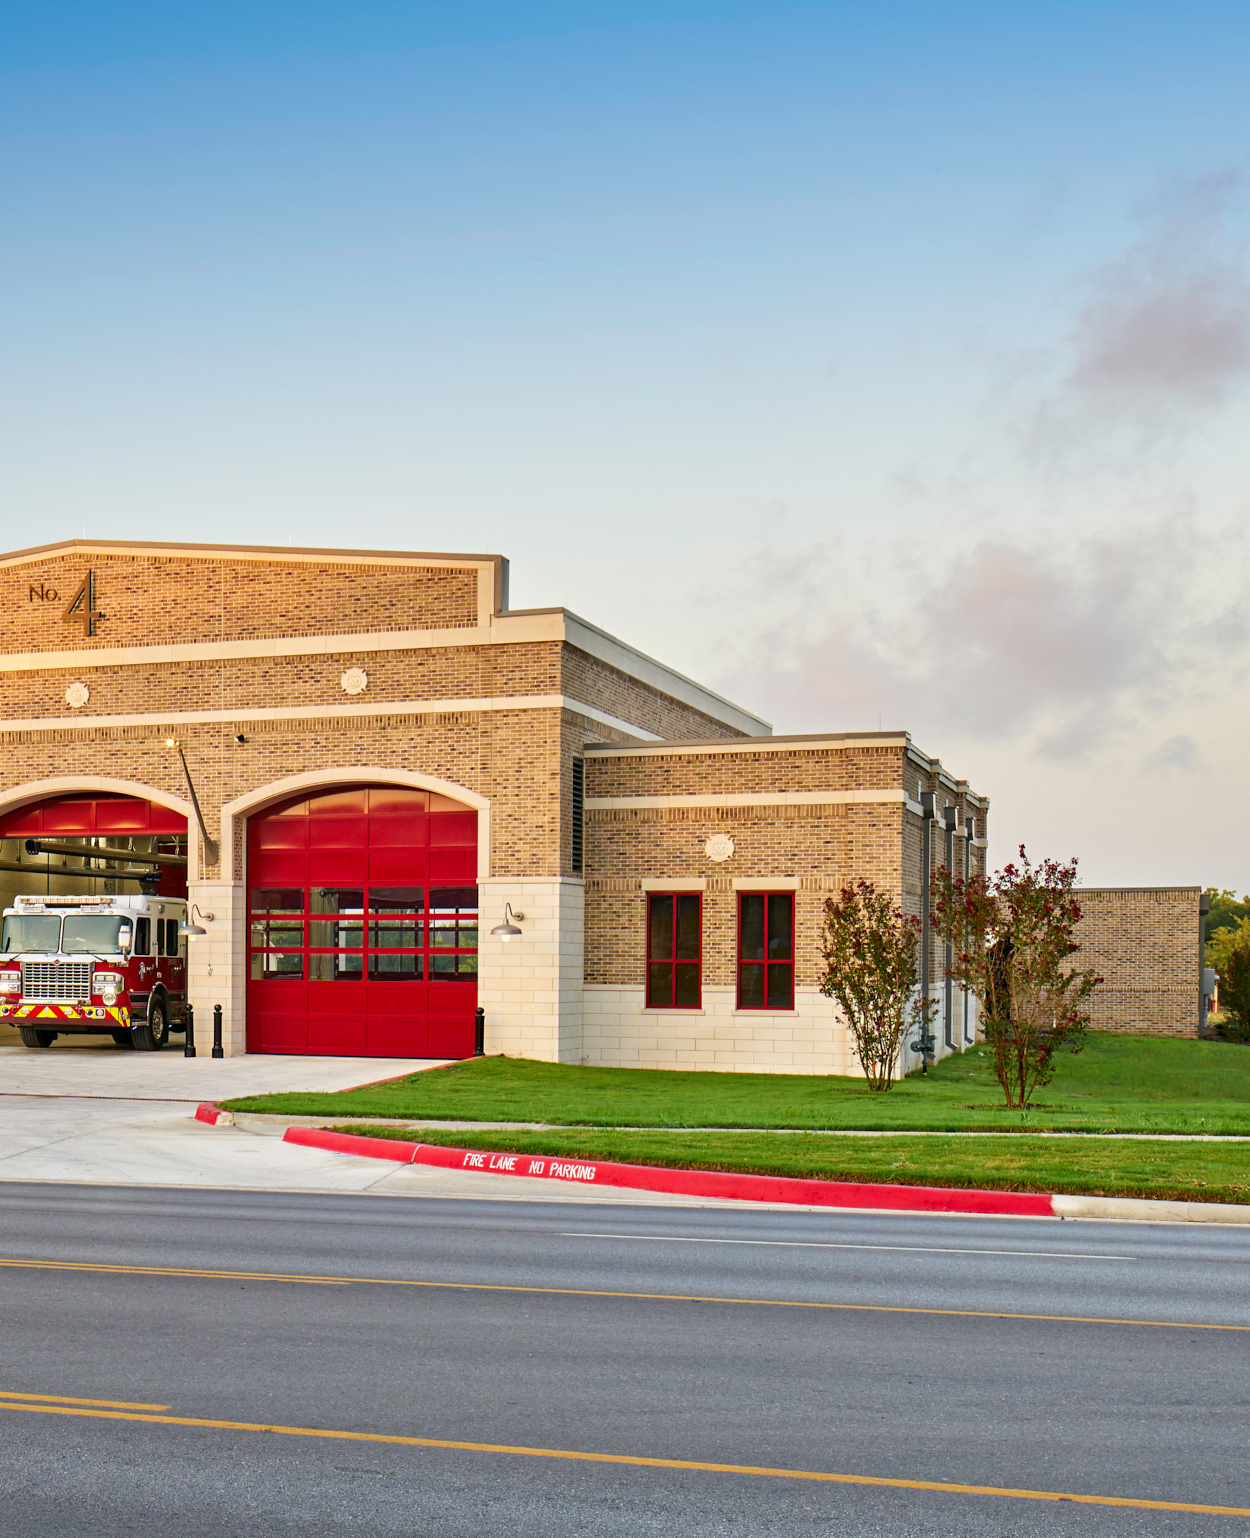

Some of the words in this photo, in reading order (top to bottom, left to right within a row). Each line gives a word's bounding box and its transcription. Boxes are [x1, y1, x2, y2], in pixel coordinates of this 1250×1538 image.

[29, 584, 61, 602] No.
[60, 569, 102, 637] 4
[463, 1153, 486, 1167] FIRE
[490, 1155, 518, 1170] LANE
[529, 1161, 544, 1174] NO
[549, 1163, 596, 1180] PARKING
